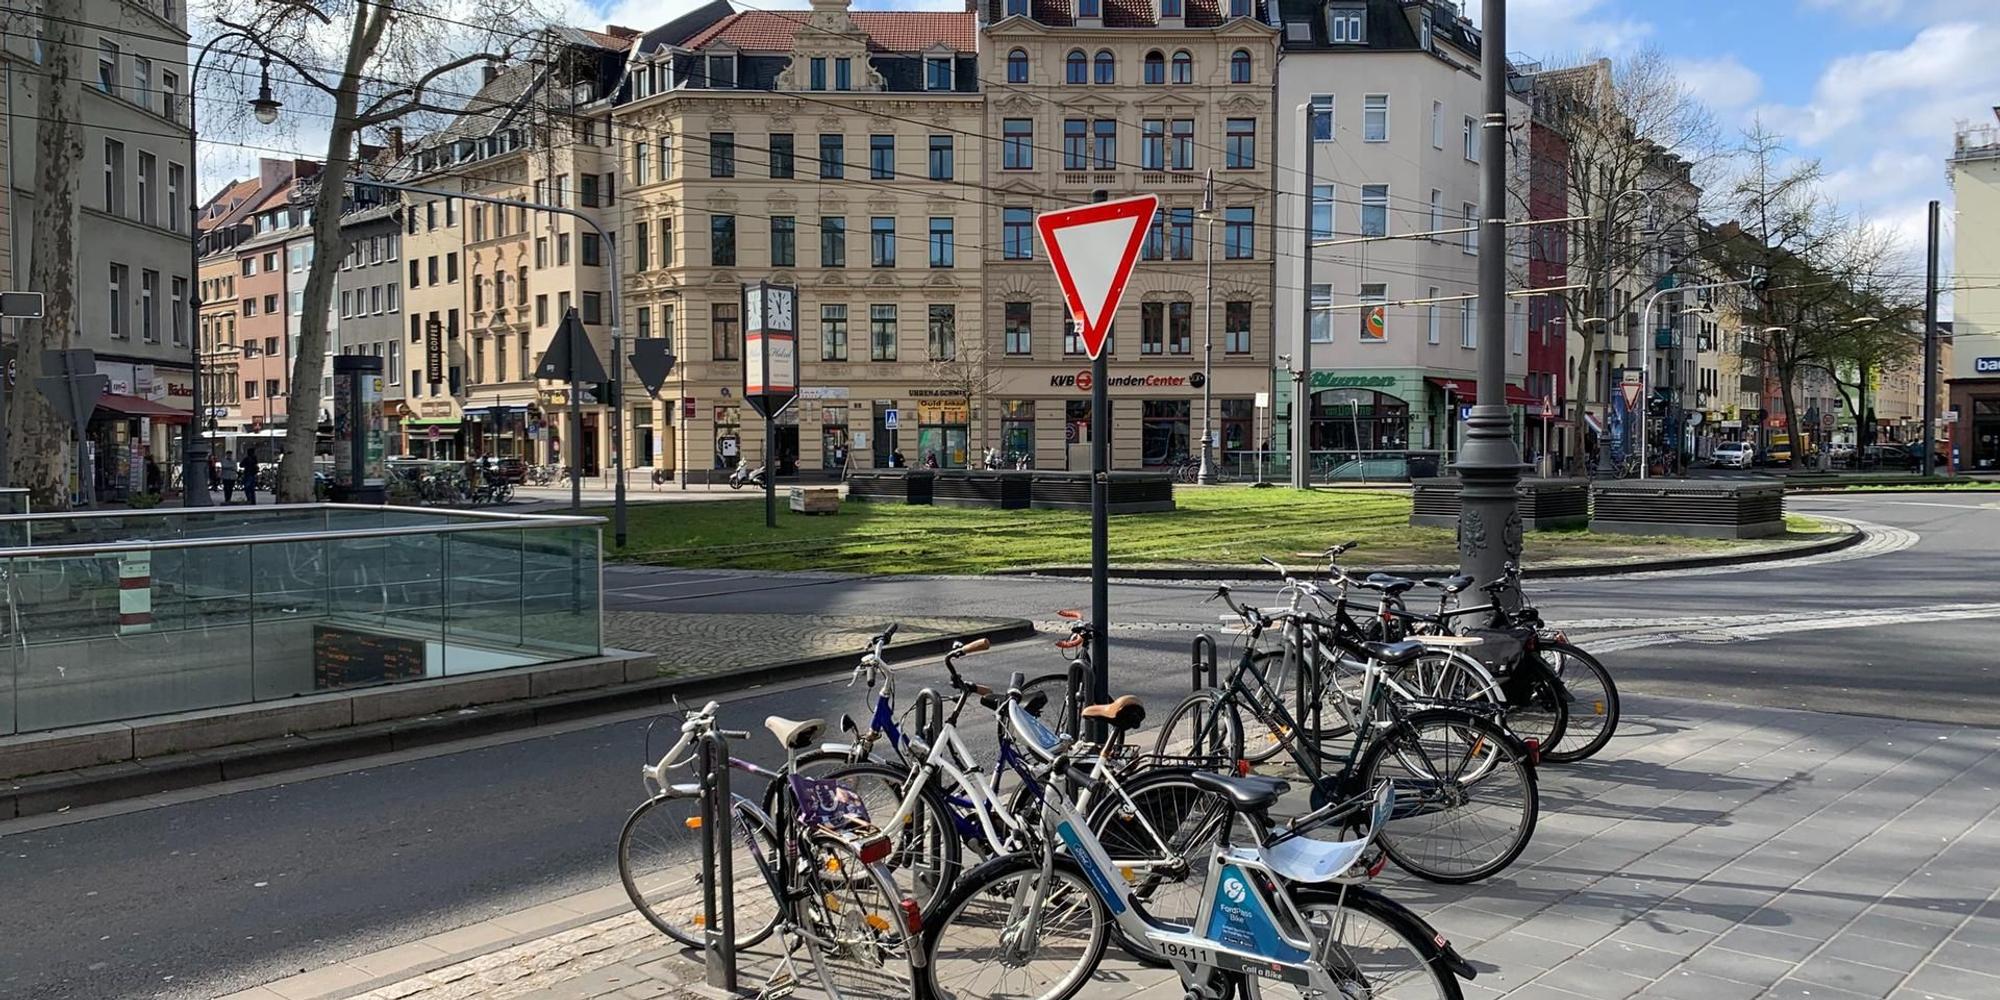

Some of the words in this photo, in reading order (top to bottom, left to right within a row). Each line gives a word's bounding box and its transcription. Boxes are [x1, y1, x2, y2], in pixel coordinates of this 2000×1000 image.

[430, 324, 438, 351] COFFEE
[1978, 359, 2000, 370] ba
[1051, 375, 1075, 387] KVB
[1108, 374, 1186, 387] undenCenter
[1311, 371, 1396, 387] Blumen
[1462, 408, 1472, 418] U
[1220, 904, 1252, 918] FordPass
[1230, 913, 1244, 923] Bike
[1160, 942, 1207, 962] 19411
[1242, 964, 1257, 974] Call
[1265, 969, 1282, 980] Bike
